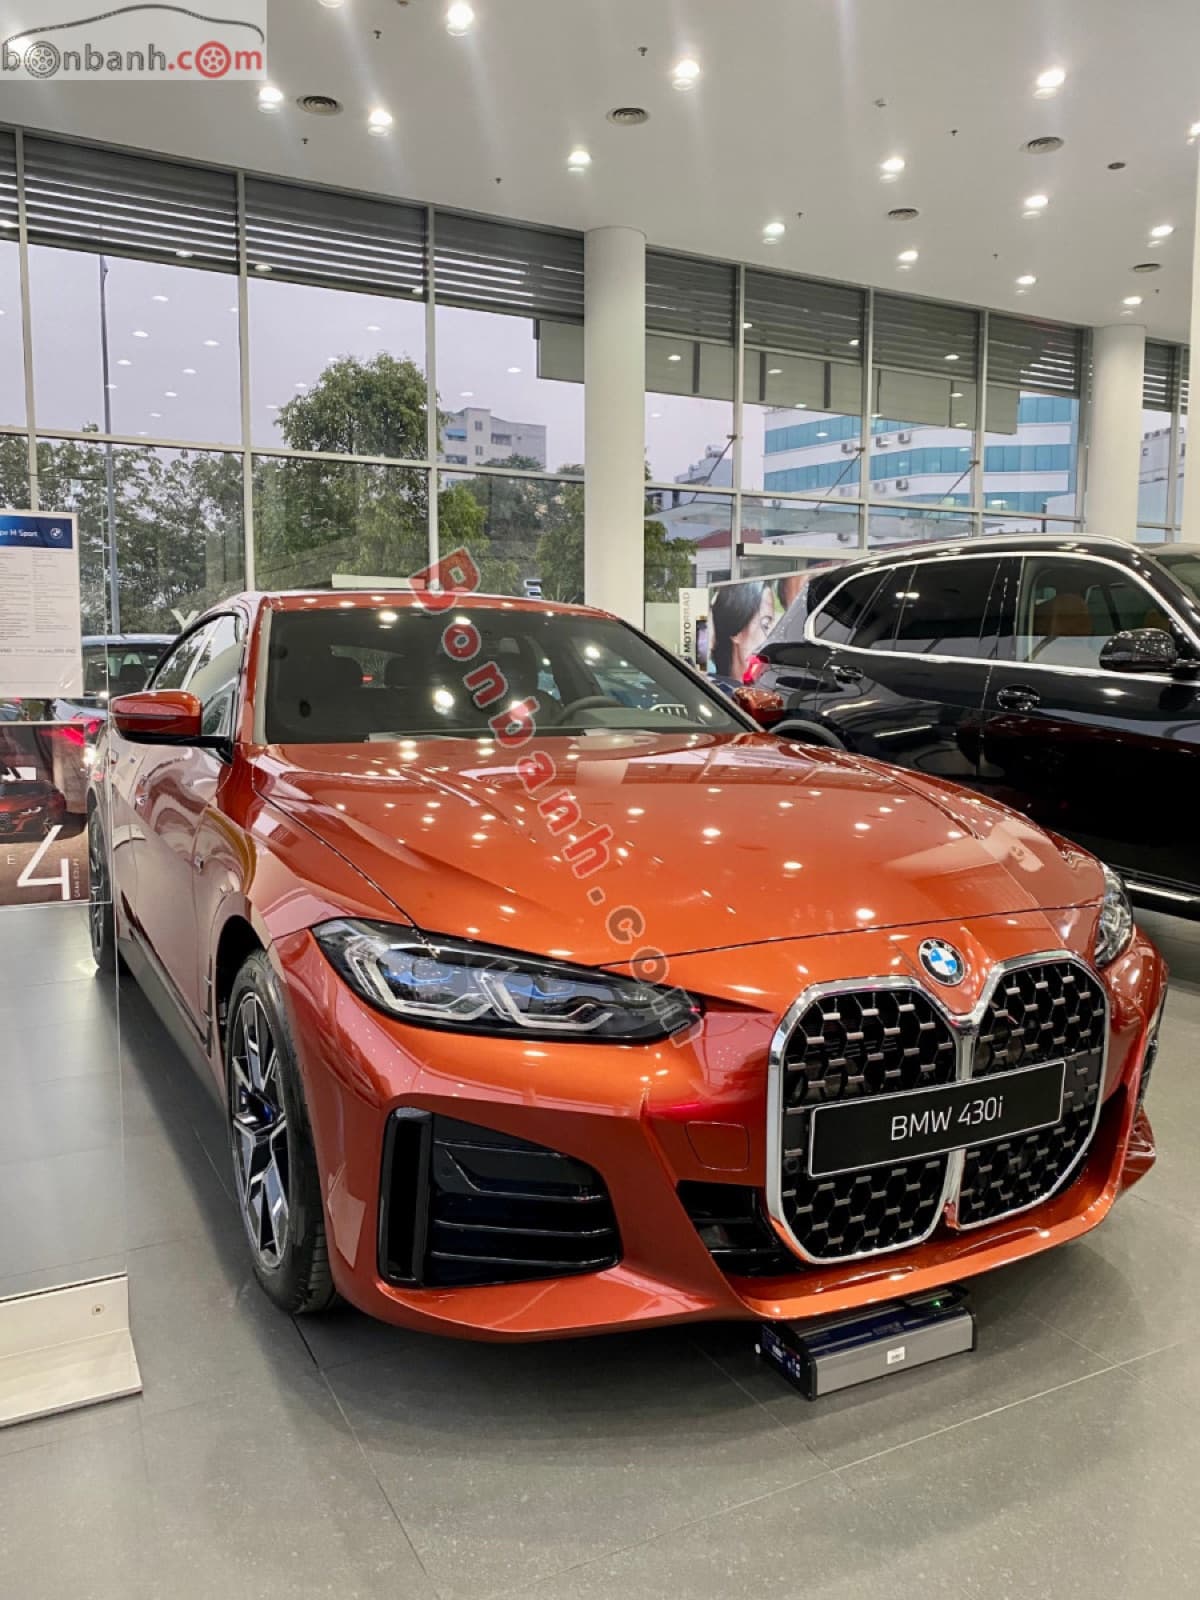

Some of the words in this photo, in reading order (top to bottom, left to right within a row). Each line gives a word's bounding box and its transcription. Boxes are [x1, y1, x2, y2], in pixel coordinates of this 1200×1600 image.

[682, 592, 692, 653] MOTORRAD
[17, 824, 71, 900] 4
[891, 1106, 953, 1141] BMW
[957, 1096, 1003, 1127] 430i
